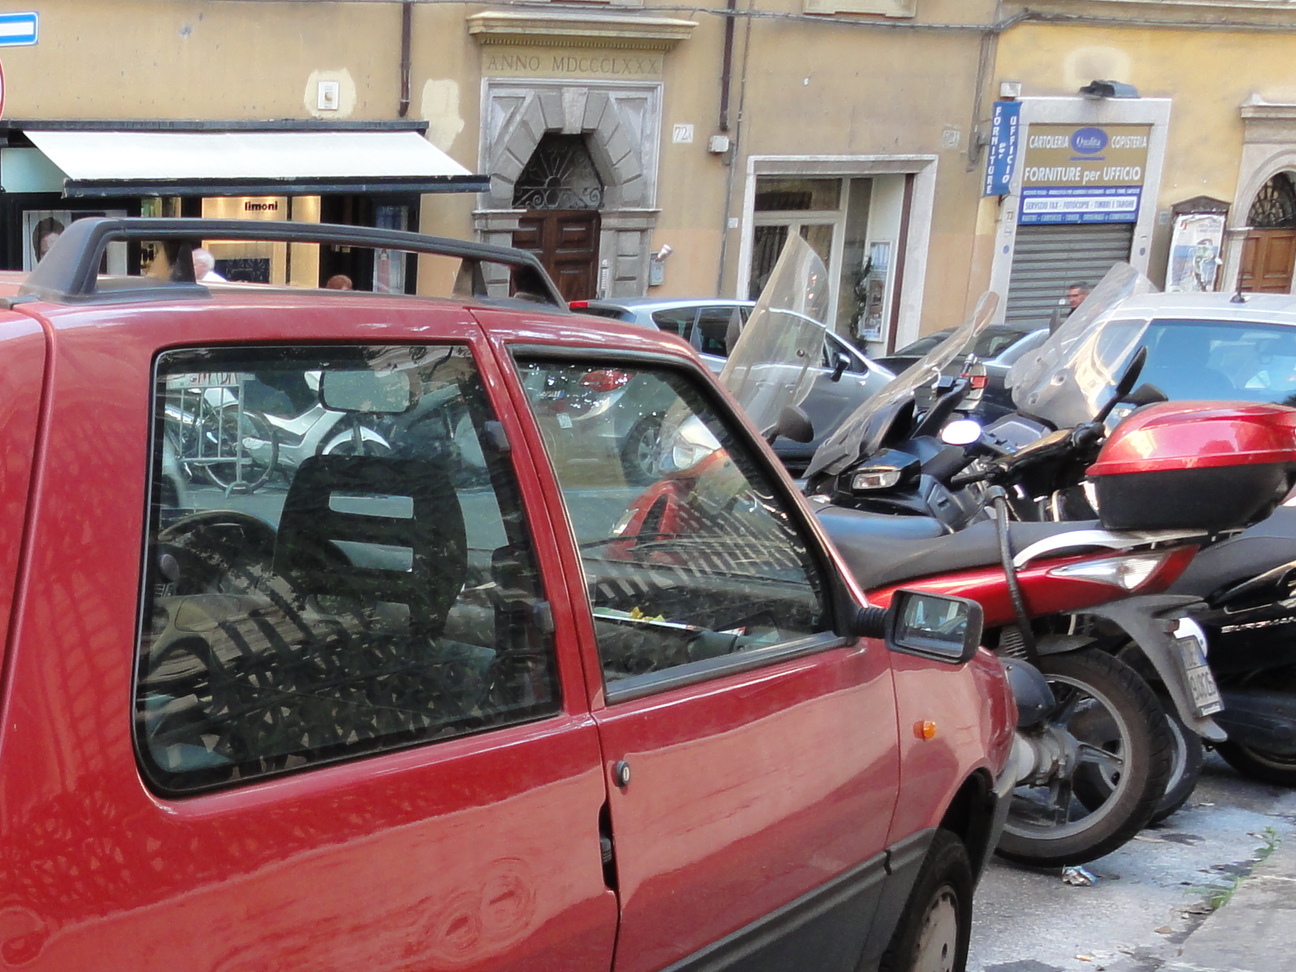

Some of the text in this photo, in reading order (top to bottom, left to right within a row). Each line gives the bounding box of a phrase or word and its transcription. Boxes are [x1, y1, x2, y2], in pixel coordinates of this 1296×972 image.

[487, 55, 659, 75] ANNO MDCCCLXXX
[1029, 135, 1069, 148] CARTOLERIA
[1111, 135, 1147, 148] COPISTERIA
[1024, 166, 1141, 186] FORNITURE per UFFICIO
[245, 200, 278, 211] limoni
